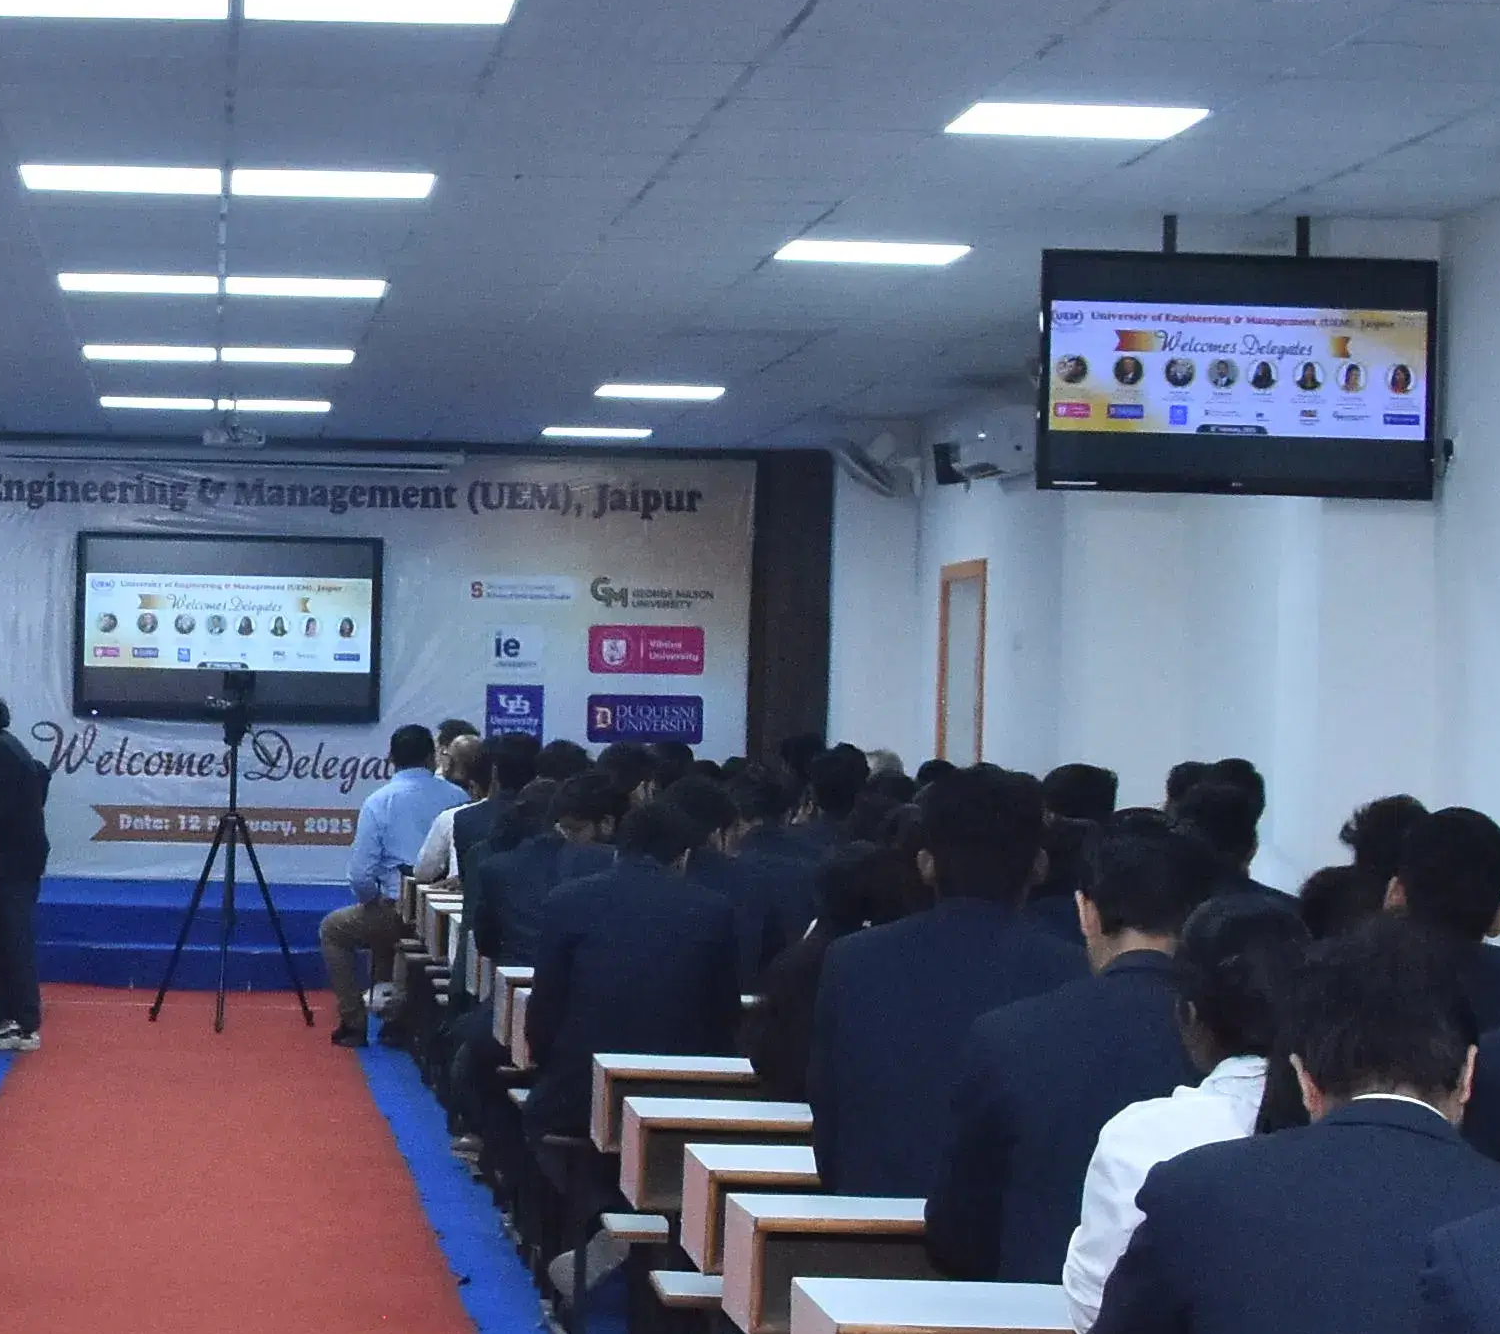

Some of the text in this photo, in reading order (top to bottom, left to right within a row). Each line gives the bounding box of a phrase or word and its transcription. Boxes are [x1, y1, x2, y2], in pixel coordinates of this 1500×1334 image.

[1154, 329, 1313, 360] Welcomes Delegates
[201, 477, 226, 505] &
[234, 478, 458, 515] Management
[467, 479, 583, 519] (UEM),
[592, 481, 703, 520] Jaipur
[166, 593, 228, 611] Welcomes
[495, 630, 521, 658] ie
[649, 650, 699, 662] University
[616, 705, 697, 719] DUQUESNE
[616, 718, 697, 732] UNIVERSITY
[31, 721, 238, 777] Welcomes
[119, 813, 171, 831] Date:
[178, 814, 201, 831] 12
[303, 817, 352, 834] 2025
